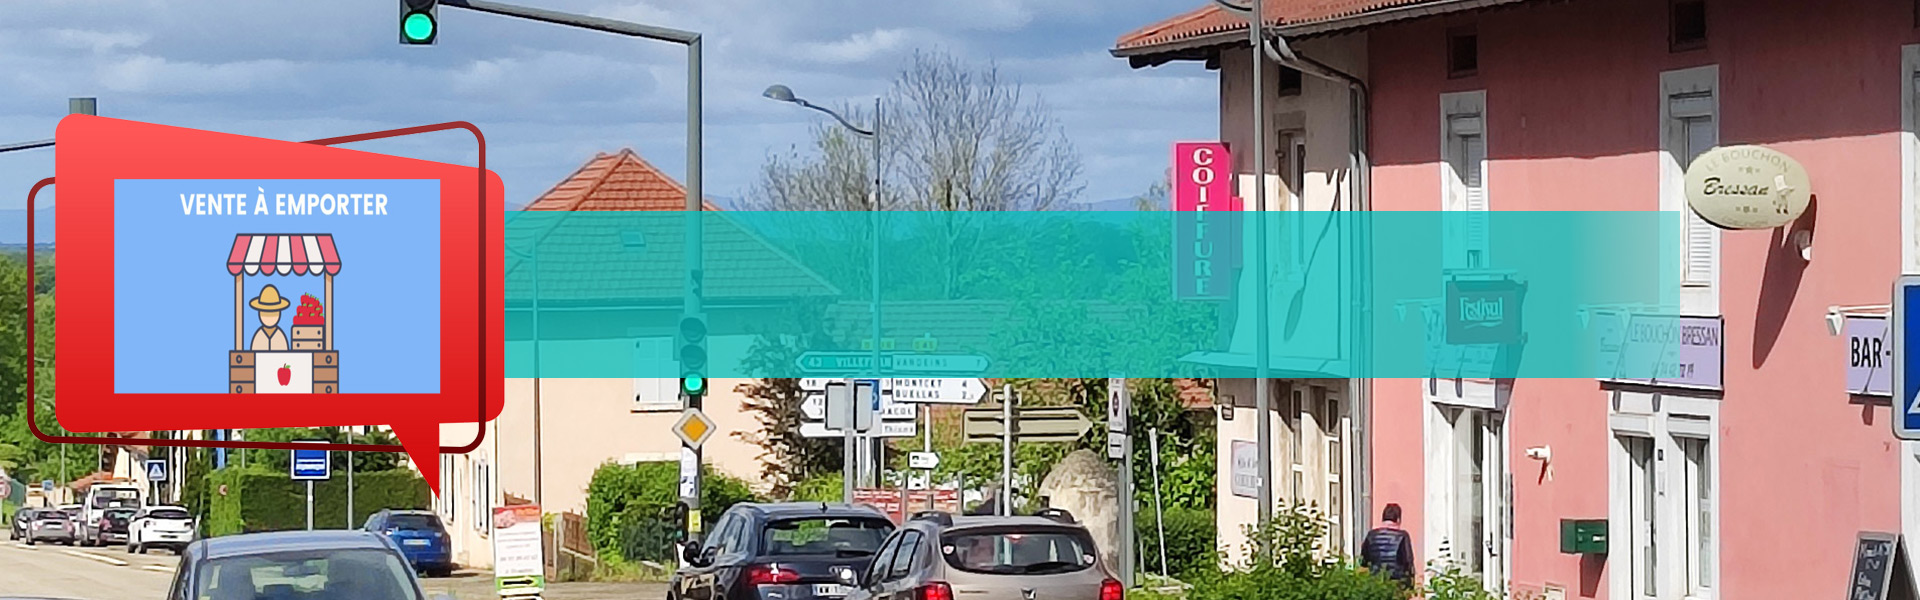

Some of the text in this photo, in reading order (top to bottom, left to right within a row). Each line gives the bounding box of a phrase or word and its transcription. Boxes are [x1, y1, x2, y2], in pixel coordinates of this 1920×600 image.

[1721, 150, 1791, 173] BOUCHON
[1703, 177, 1770, 196] Bressan
[1191, 147, 1216, 296] COIFFURE
[1681, 325, 1719, 347] BRESSAN
[896, 358, 948, 368] VANDEINS
[1850, 336, 1883, 368] BAR
[895, 389, 941, 400] BUELLAS
